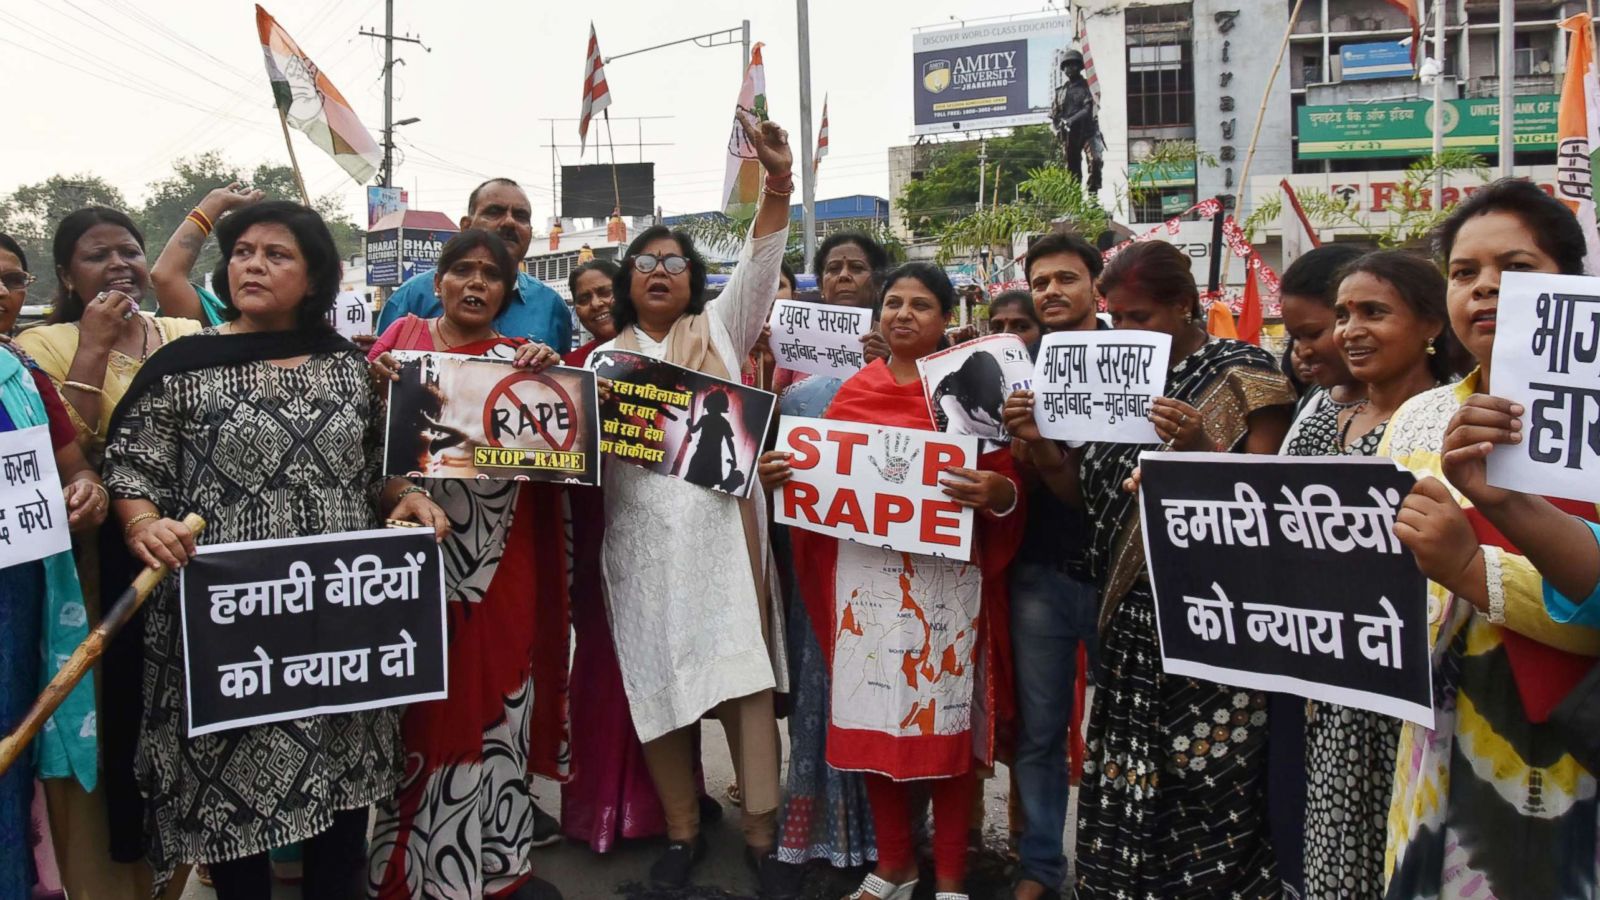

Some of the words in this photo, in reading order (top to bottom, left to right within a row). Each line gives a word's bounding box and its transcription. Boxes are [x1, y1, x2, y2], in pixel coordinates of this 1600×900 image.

[923, 31, 960, 45] DISCOVER
[961, 26, 1016, 40] WORLD-CLASS
[1018, 20, 1065, 33] EDUCATION
[953, 51, 1016, 74] AMITY
[953, 69, 1016, 85] UNIVERSITY
[962, 80, 1008, 91] JHARKHAND
[1470, 104, 1500, 116] UNITE
[1513, 102, 1535, 114] ANK
[1538, 101, 1551, 113] OF
[368, 240, 398, 253] BHARAT
[403, 239, 444, 251] BHAR
[403, 249, 443, 258] ELECTRO
[345, 296, 365, 324] को
[780, 305, 811, 335] रघुवर
[817, 309, 862, 335] सरकार
[1043, 343, 1088, 384] भाजपा
[1096, 344, 1157, 386] सरकार
[613, 380, 634, 396] रहा
[490, 402, 571, 440] RAPE
[619, 402, 637, 417] पर
[637, 405, 658, 420] वार
[603, 417, 620, 433] सो
[620, 423, 641, 438] रहा
[644, 424, 665, 442] देश
[476, 449, 526, 466] STOP
[534, 453, 581, 469] RAPE
[614, 438, 665, 462] चौकीदार
[2, 450, 40, 486] करना
[15, 489, 53, 534] करो
[783, 480, 963, 547] RAPE
[1161, 482, 1270, 548] हमारी
[1274, 484, 1402, 554] बेटियों
[208, 561, 316, 625] हमारी
[324, 552, 426, 607] बेटियों
[1183, 581, 1237, 645] को
[1243, 602, 1344, 660] न्याय
[1354, 596, 1404, 669] दो
[218, 645, 274, 699] को
[282, 648, 371, 687] न्याय
[378, 629, 417, 677] दो
